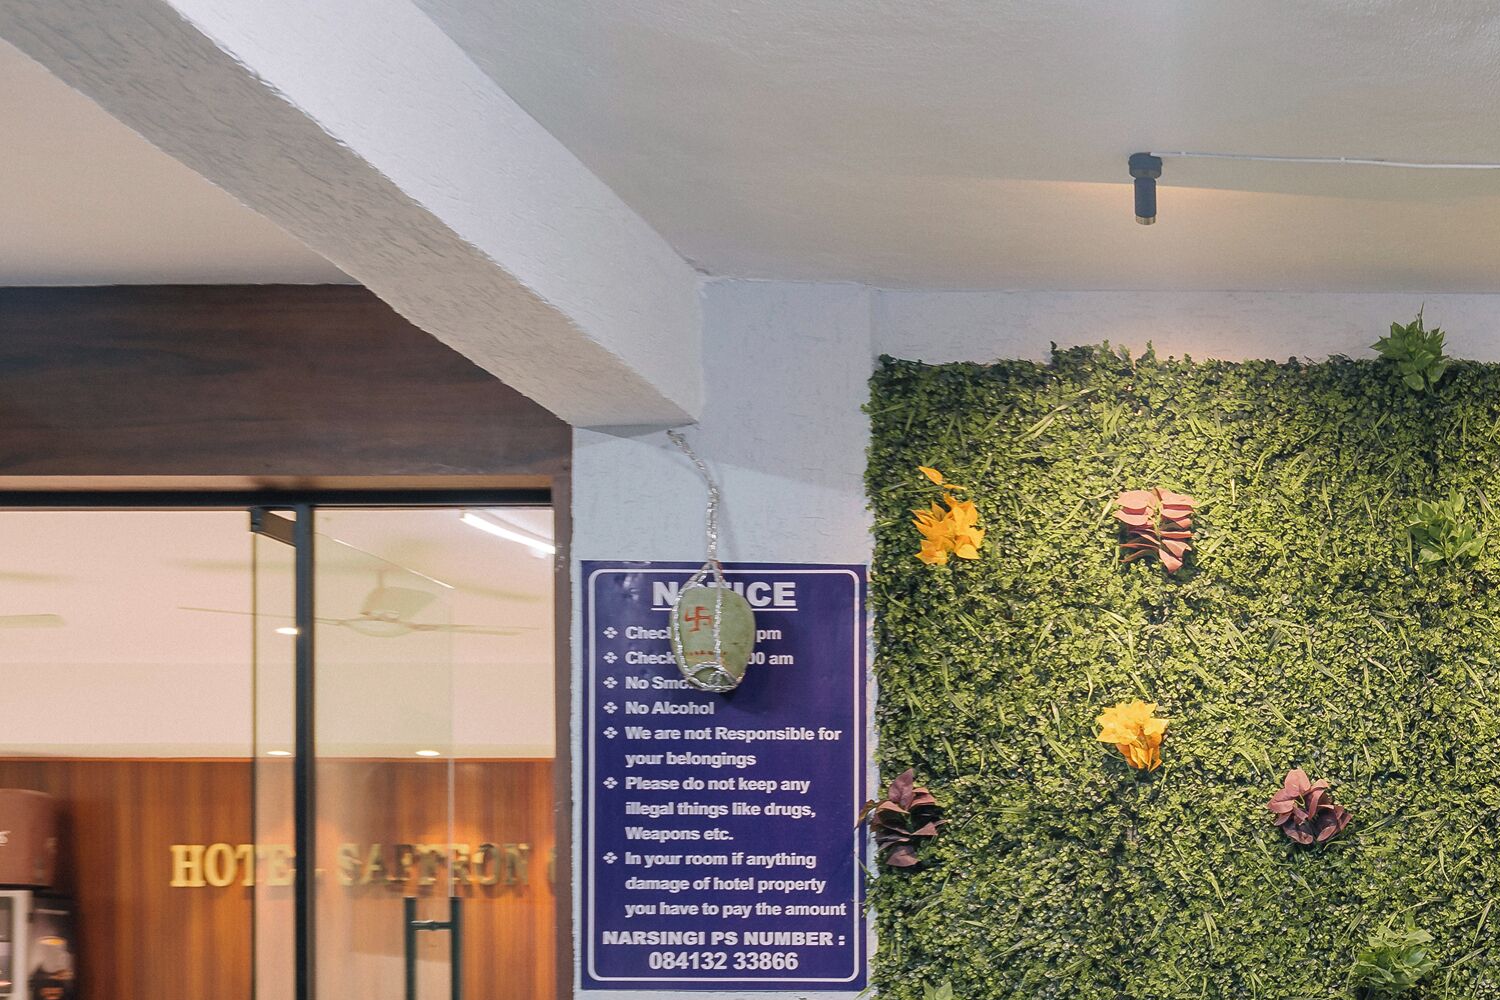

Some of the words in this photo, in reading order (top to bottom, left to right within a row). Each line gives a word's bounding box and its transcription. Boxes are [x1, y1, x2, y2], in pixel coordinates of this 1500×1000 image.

[652, 581, 797, 607] NICE
[757, 629, 782, 644] pm
[769, 654, 794, 665] am
[625, 676, 650, 690] No
[625, 701, 650, 715] No
[652, 700, 715, 715] Alcohol
[625, 726, 651, 740] We
[653, 730, 680, 740] are
[683, 727, 712, 740] not
[715, 726, 815, 744] Responsible
[818, 726, 843, 740] for
[625, 755, 664, 769] your
[666, 751, 757, 769] belongings
[625, 776, 679, 790] Please
[682, 777, 706, 790] do
[708, 777, 736, 790] not
[738, 776, 778, 794] keep
[780, 780, 812, 795] any
[625, 801, 675, 819] illegal
[677, 801, 730, 819] things
[731, 801, 761, 815] like
[763, 801, 817, 820] drugs,
[625, 826, 701, 844] Weapons
[703, 827, 735, 841] etc.
[169, 843, 323, 888] HOTE
[625, 851, 642, 865] In
[643, 855, 682, 869] your
[685, 855, 729, 865] room
[731, 851, 744, 865] if
[745, 851, 817, 869] anything
[625, 876, 690, 894] damage
[692, 876, 711, 890] of
[713, 876, 755, 890] hotel
[757, 877, 827, 895] property
[625, 904, 657, 919] you
[659, 901, 700, 916] have
[701, 902, 720, 916] to
[722, 904, 753, 919] pay
[754, 901, 783, 916] the
[784, 902, 847, 916] amount
[602, 930, 706, 946] NARSINGI
[710, 931, 739, 946] PS
[743, 931, 835, 946] NUMBER
[648, 951, 728, 970] 084132
[732, 951, 799, 971] 33866
